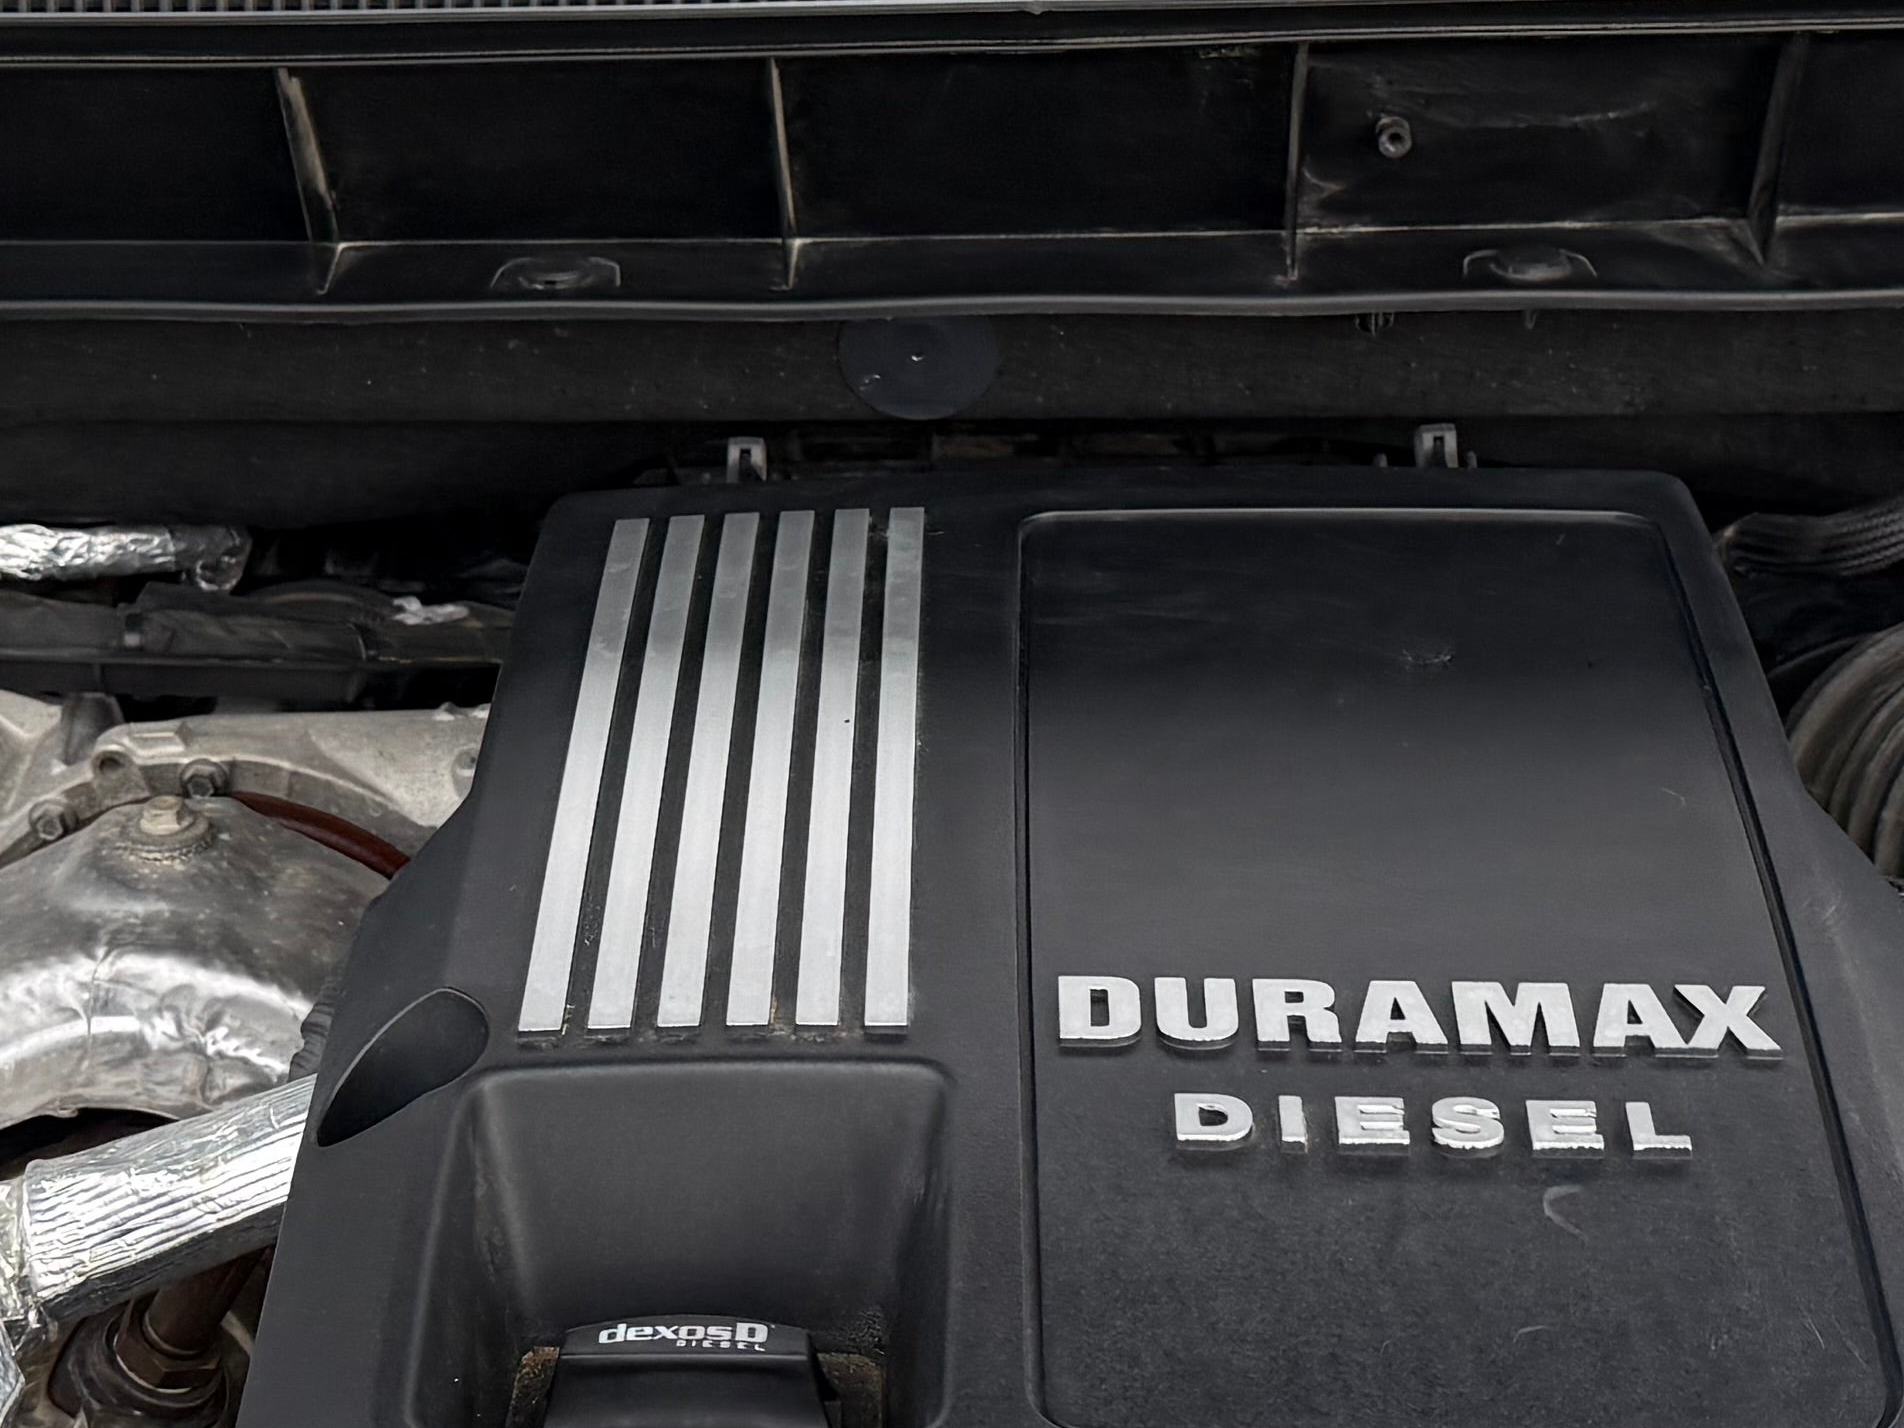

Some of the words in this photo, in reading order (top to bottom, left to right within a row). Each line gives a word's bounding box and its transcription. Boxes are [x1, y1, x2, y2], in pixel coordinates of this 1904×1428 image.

[1057, 974, 1784, 1059] DURAMAX
[1174, 1092, 1694, 1159] DIESEL
[676, 1339, 766, 1352] DIESEL
